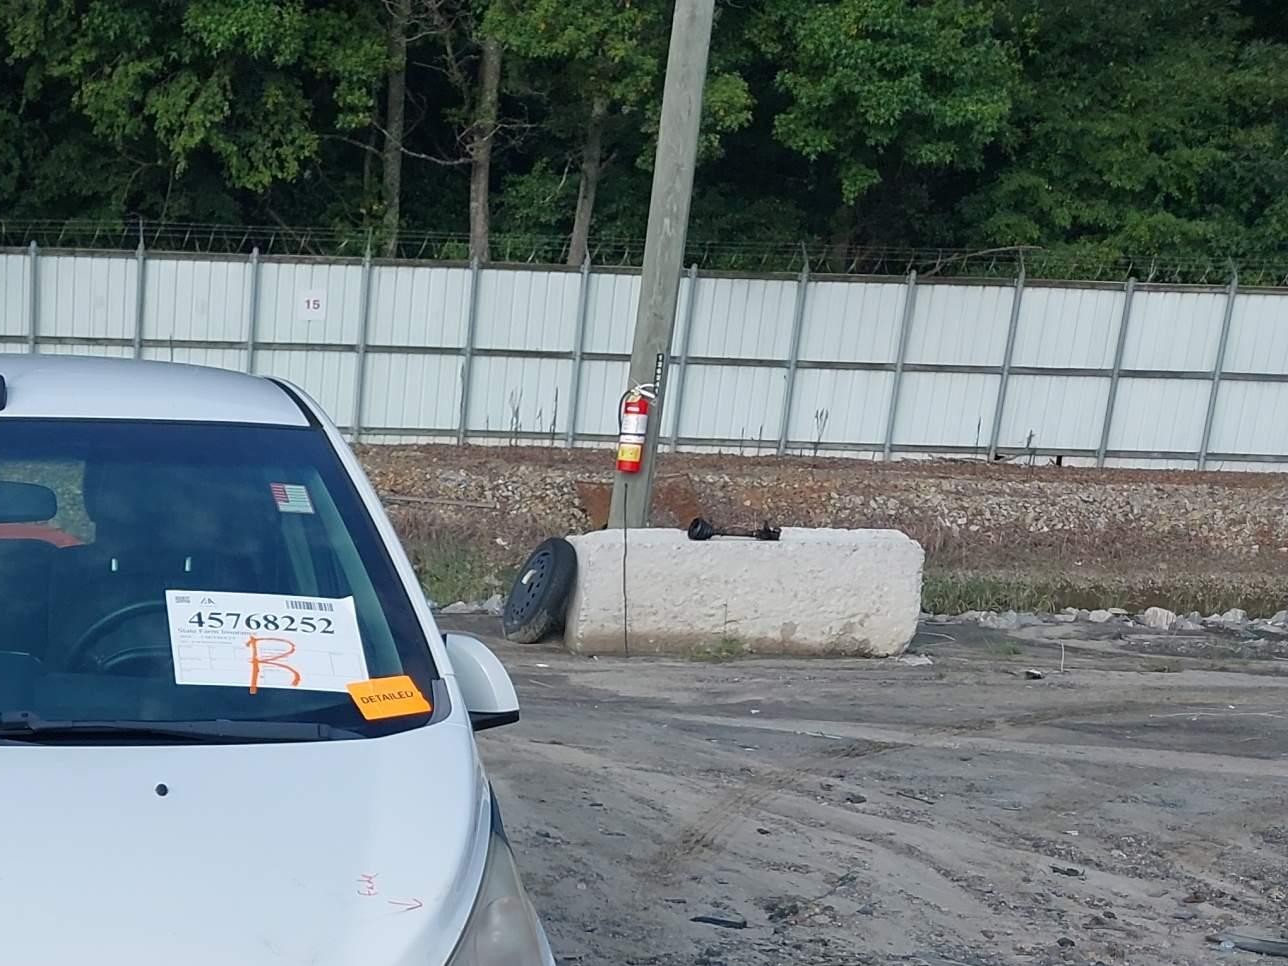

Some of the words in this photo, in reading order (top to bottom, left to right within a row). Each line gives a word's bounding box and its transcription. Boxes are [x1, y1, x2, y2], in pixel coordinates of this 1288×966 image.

[305, 299, 321, 310] 15
[188, 611, 335, 635] 45768252
[360, 690, 414, 704] DETAILED
